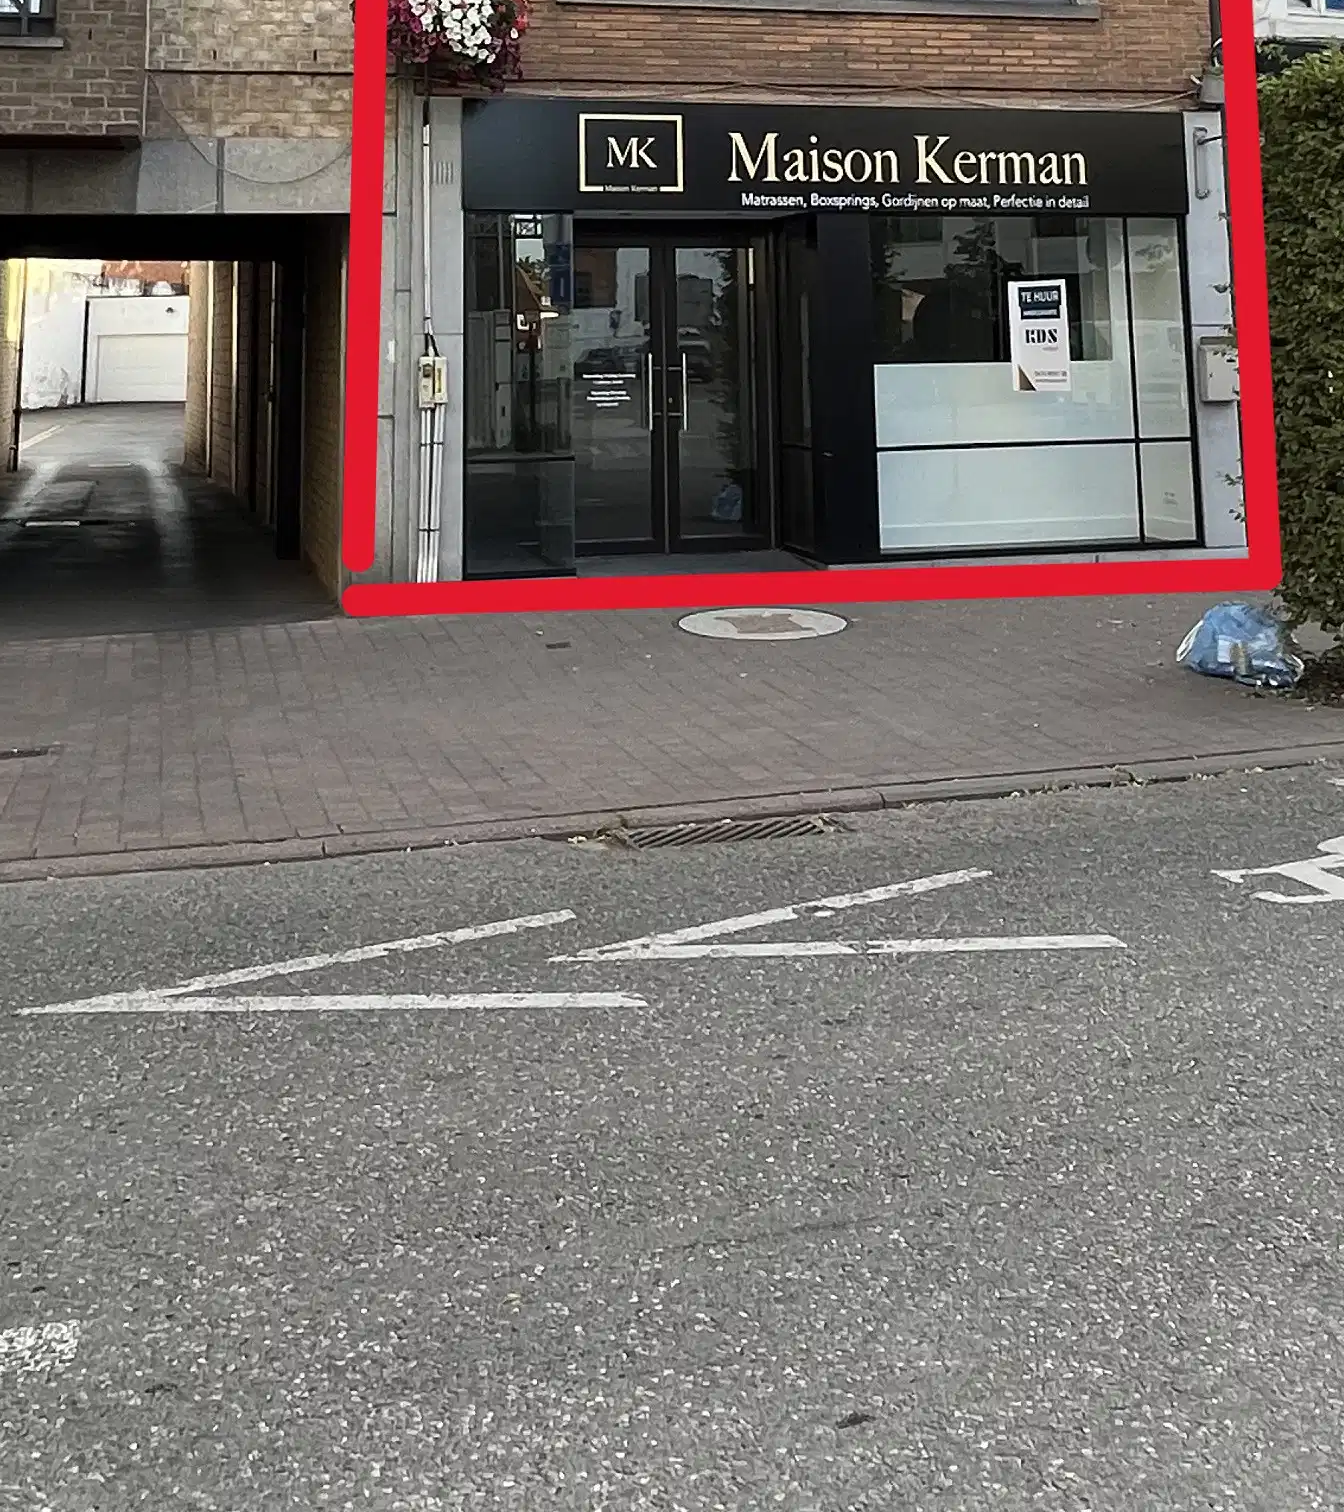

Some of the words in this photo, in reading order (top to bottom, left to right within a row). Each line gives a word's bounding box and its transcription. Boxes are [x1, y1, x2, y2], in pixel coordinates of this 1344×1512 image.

[606, 136, 657, 168] MK
[727, 132, 900, 183] Maison
[913, 134, 1088, 185] Kerman
[741, 193, 807, 208] Matrassen,
[810, 193, 879, 210] Boxsprings,
[881, 193, 938, 211] Gordijnen
[941, 197, 956, 210] op
[959, 196, 991, 209] maat,
[993, 194, 1042, 208] Perfectie
[1045, 194, 1055, 208] in
[1058, 195, 1089, 209] detail
[1021, 291, 1032, 303] TE
[1033, 291, 1059, 303] HUUR
